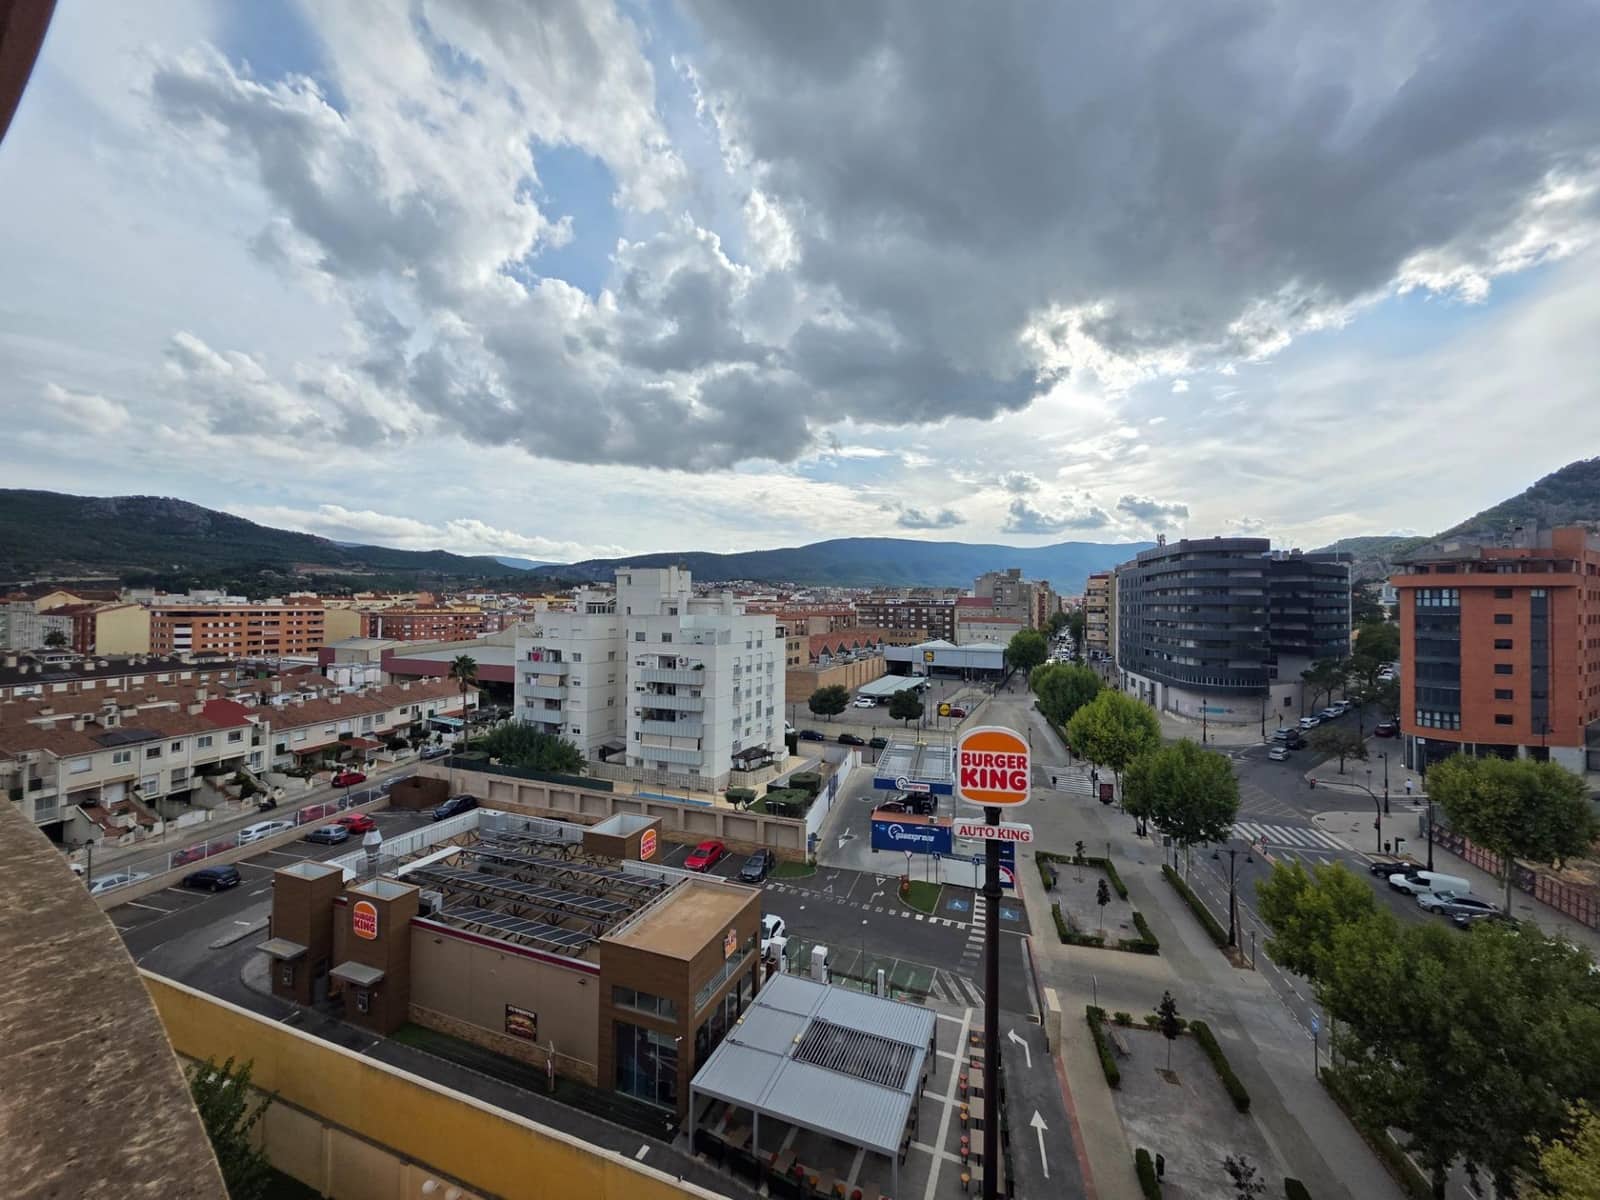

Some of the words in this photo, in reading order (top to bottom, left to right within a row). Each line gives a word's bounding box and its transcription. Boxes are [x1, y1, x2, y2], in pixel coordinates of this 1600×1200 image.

[960, 752, 1027, 770] BURGER
[960, 767, 1027, 791] KING
[959, 825, 995, 838] AUTO
[997, 828, 1030, 842] KING
[354, 918, 375, 933] KING
